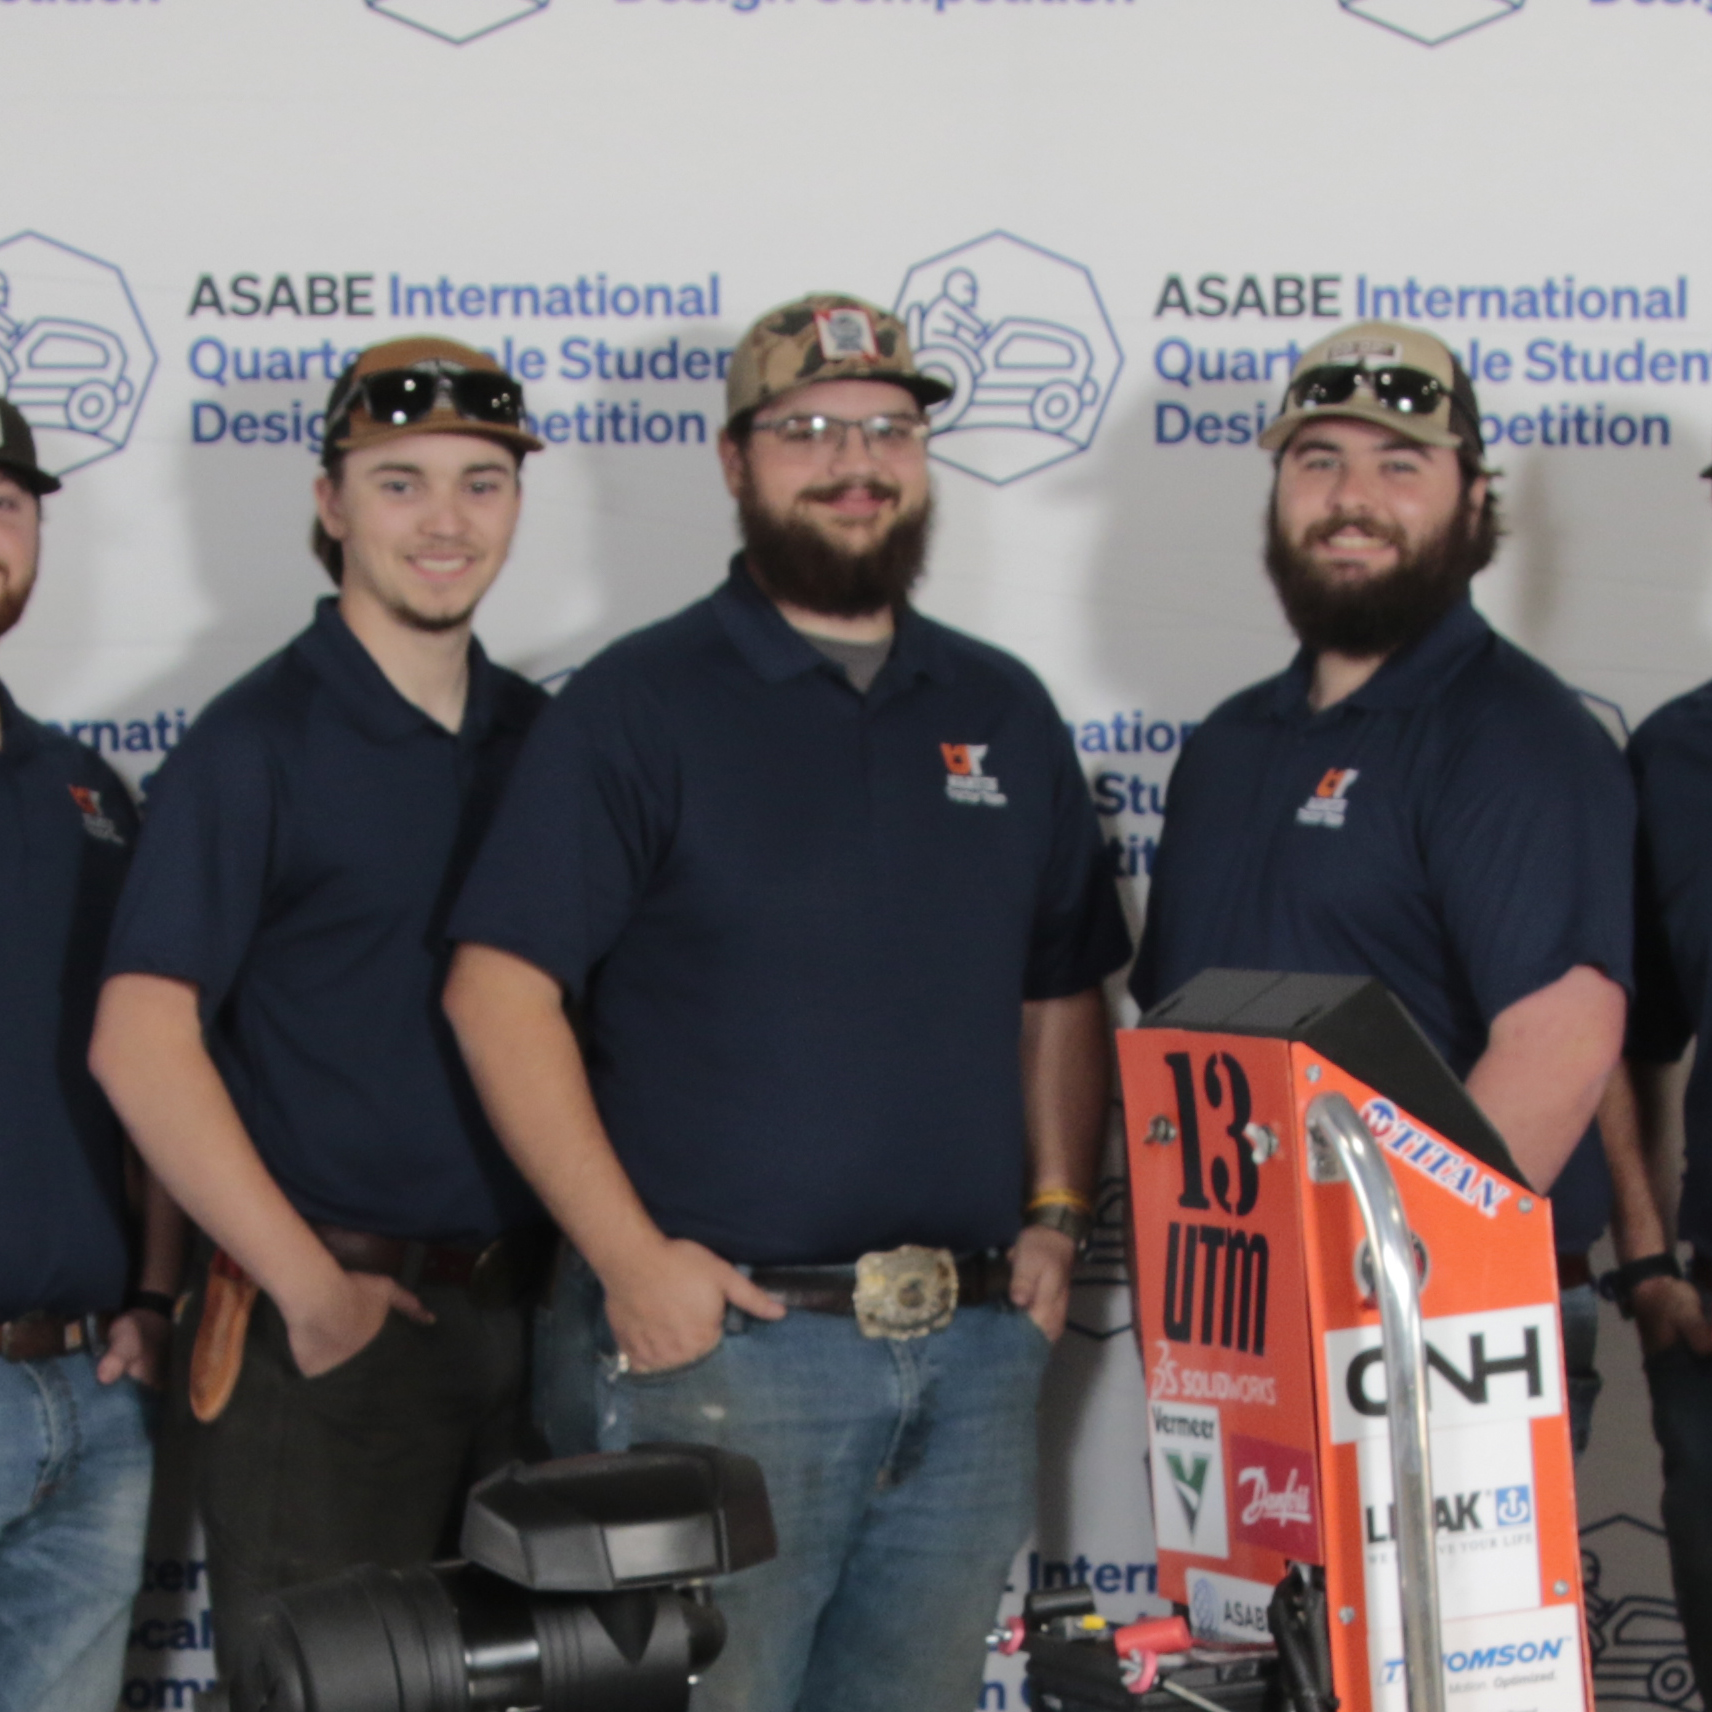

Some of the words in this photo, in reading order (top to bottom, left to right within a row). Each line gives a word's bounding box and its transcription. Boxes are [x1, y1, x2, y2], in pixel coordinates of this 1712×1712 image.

[188, 274, 373, 316] ASABE
[390, 273, 719, 317] International
[1155, 274, 1340, 317] ASABE
[1354, 275, 1687, 319] International
[527, 401, 707, 454] petition
[1154, 403, 1265, 446] Desi
[1480, 404, 1672, 457] petition
[1165, 1051, 1259, 1216] 13
[1384, 1117, 1512, 1219] TITAN
[1163, 1222, 1270, 1357] UTM
[1152, 1406, 1215, 1440] Vermeer
[1366, 1491, 1482, 1543] LIAK
[1384, 1637, 1564, 1684] TOMSON
